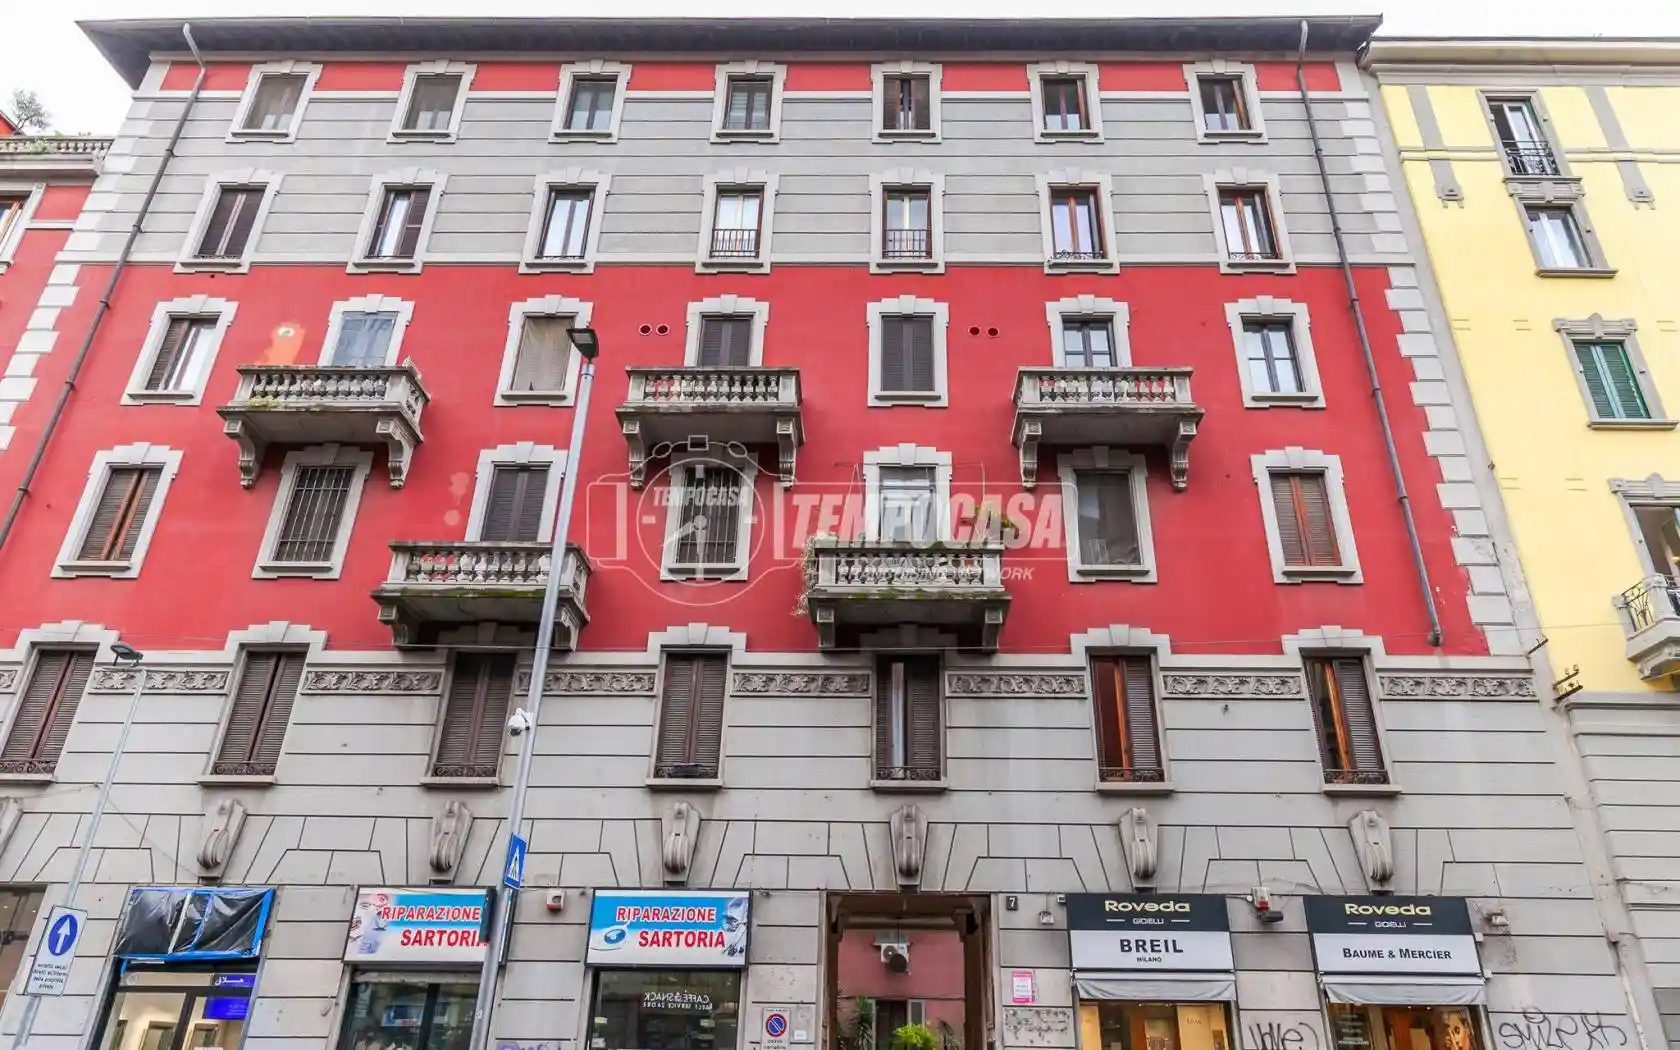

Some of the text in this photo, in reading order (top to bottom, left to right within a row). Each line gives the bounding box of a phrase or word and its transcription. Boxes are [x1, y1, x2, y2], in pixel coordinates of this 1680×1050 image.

[1009, 897, 1016, 907] 7
[1104, 900, 1190, 912] Roveda
[381, 906, 481, 920] RIPARAZIONE
[617, 907, 716, 921] RIPARAZIONE
[1344, 903, 1432, 916] Roveda
[401, 929, 488, 947] SARTORI
[638, 930, 725, 948] SARTORIA
[1119, 939, 1184, 953] BREIL
[1343, 948, 1452, 960] BAUME & MERCIER
